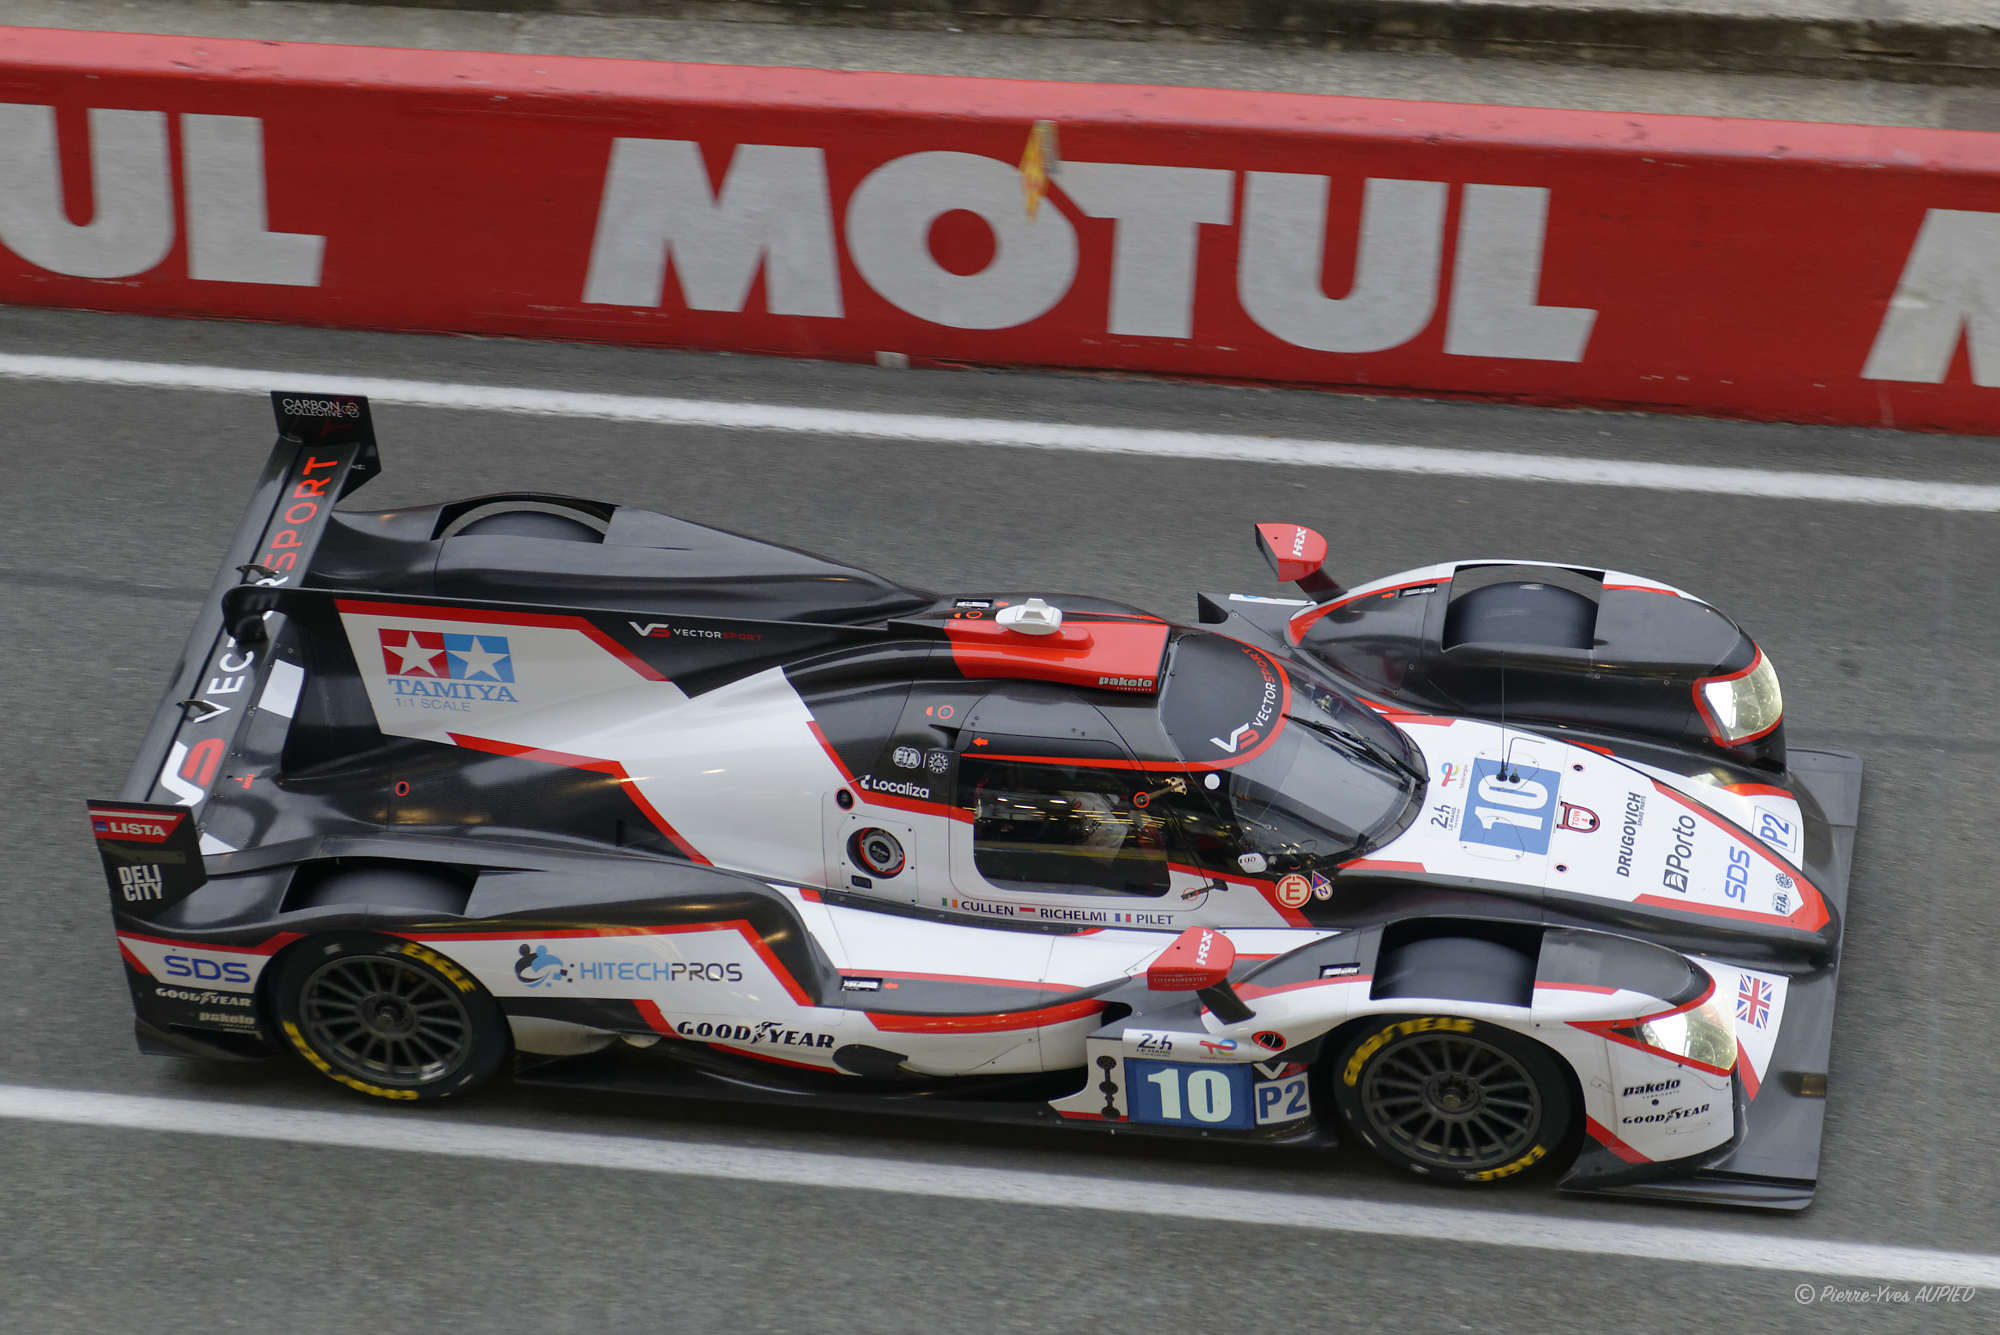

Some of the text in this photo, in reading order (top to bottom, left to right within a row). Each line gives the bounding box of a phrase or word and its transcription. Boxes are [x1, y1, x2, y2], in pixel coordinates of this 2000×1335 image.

[582, 137, 1598, 364] MOTUL
[282, 398, 339, 411] CARBON
[1292, 526, 1307, 557] HRX
[388, 678, 520, 703] TAMIYA
[420, 698, 472, 713] SCALE
[1474, 773, 1549, 832] 10
[109, 822, 167, 837] LISTA
[1616, 791, 1641, 878] DRUGOVICH
[1760, 813, 1790, 847] P2
[1666, 815, 1696, 874] Porto
[118, 864, 162, 885] DELI
[1724, 846, 1750, 903] SDS
[122, 882, 163, 902] CITY
[1285, 881, 1302, 901] E
[961, 900, 1014, 916] CULLEN
[1040, 908, 1107, 922] RICHELMI
[1136, 913, 1174, 925] PILET
[1196, 929, 1214, 966] HRX
[164, 955, 251, 983] SDS
[580, 962, 743, 982] HITECHPROS
[155, 987, 252, 1007] GOODYEAR
[677, 1021, 835, 1048] GOODYEAR
[1147, 1068, 1232, 1123] 10
[1622, 1079, 1681, 1097] pakelo
[1258, 1080, 1308, 1120] P2
[1622, 1103, 1711, 1124] GOODYEAR
